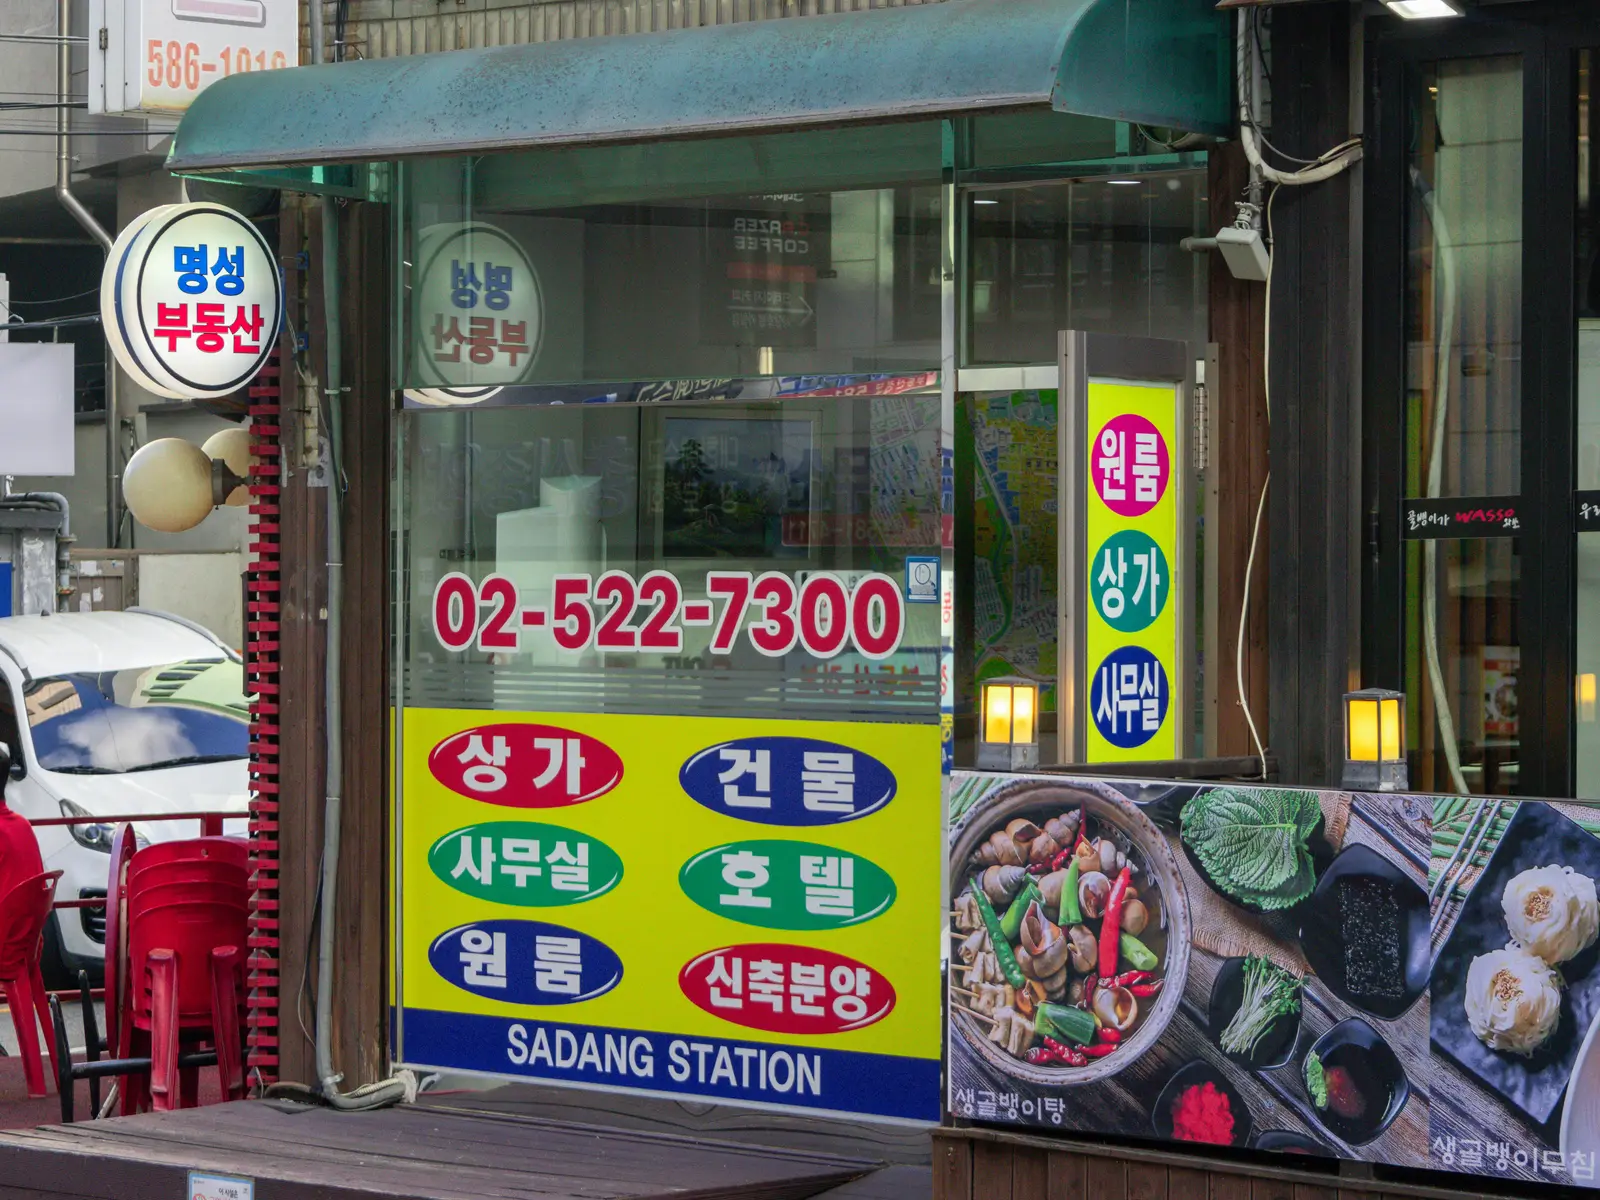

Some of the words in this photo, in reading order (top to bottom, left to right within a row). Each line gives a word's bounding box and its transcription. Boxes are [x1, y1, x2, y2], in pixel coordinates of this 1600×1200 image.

[173, 244, 245, 297] 명성
[154, 302, 265, 354] 부동산
[1098, 428, 1161, 502] 원룸
[1407, 509, 1450, 531] 골뱅이가
[1455, 508, 1515, 524] WASSO
[1097, 546, 1160, 618] 상가
[434, 570, 905, 659] 02-522-7300
[1096, 660, 1160, 734] 사무실
[450, 835, 590, 893] 사무실
[705, 955, 873, 1022] 신축분양
[506, 1023, 655, 1078] SADANG
[667, 1037, 822, 1096] STATION
[954, 1088, 1066, 1125] 생골뱅이탕
[1431, 1135, 1596, 1181] 생골뱅이무침
